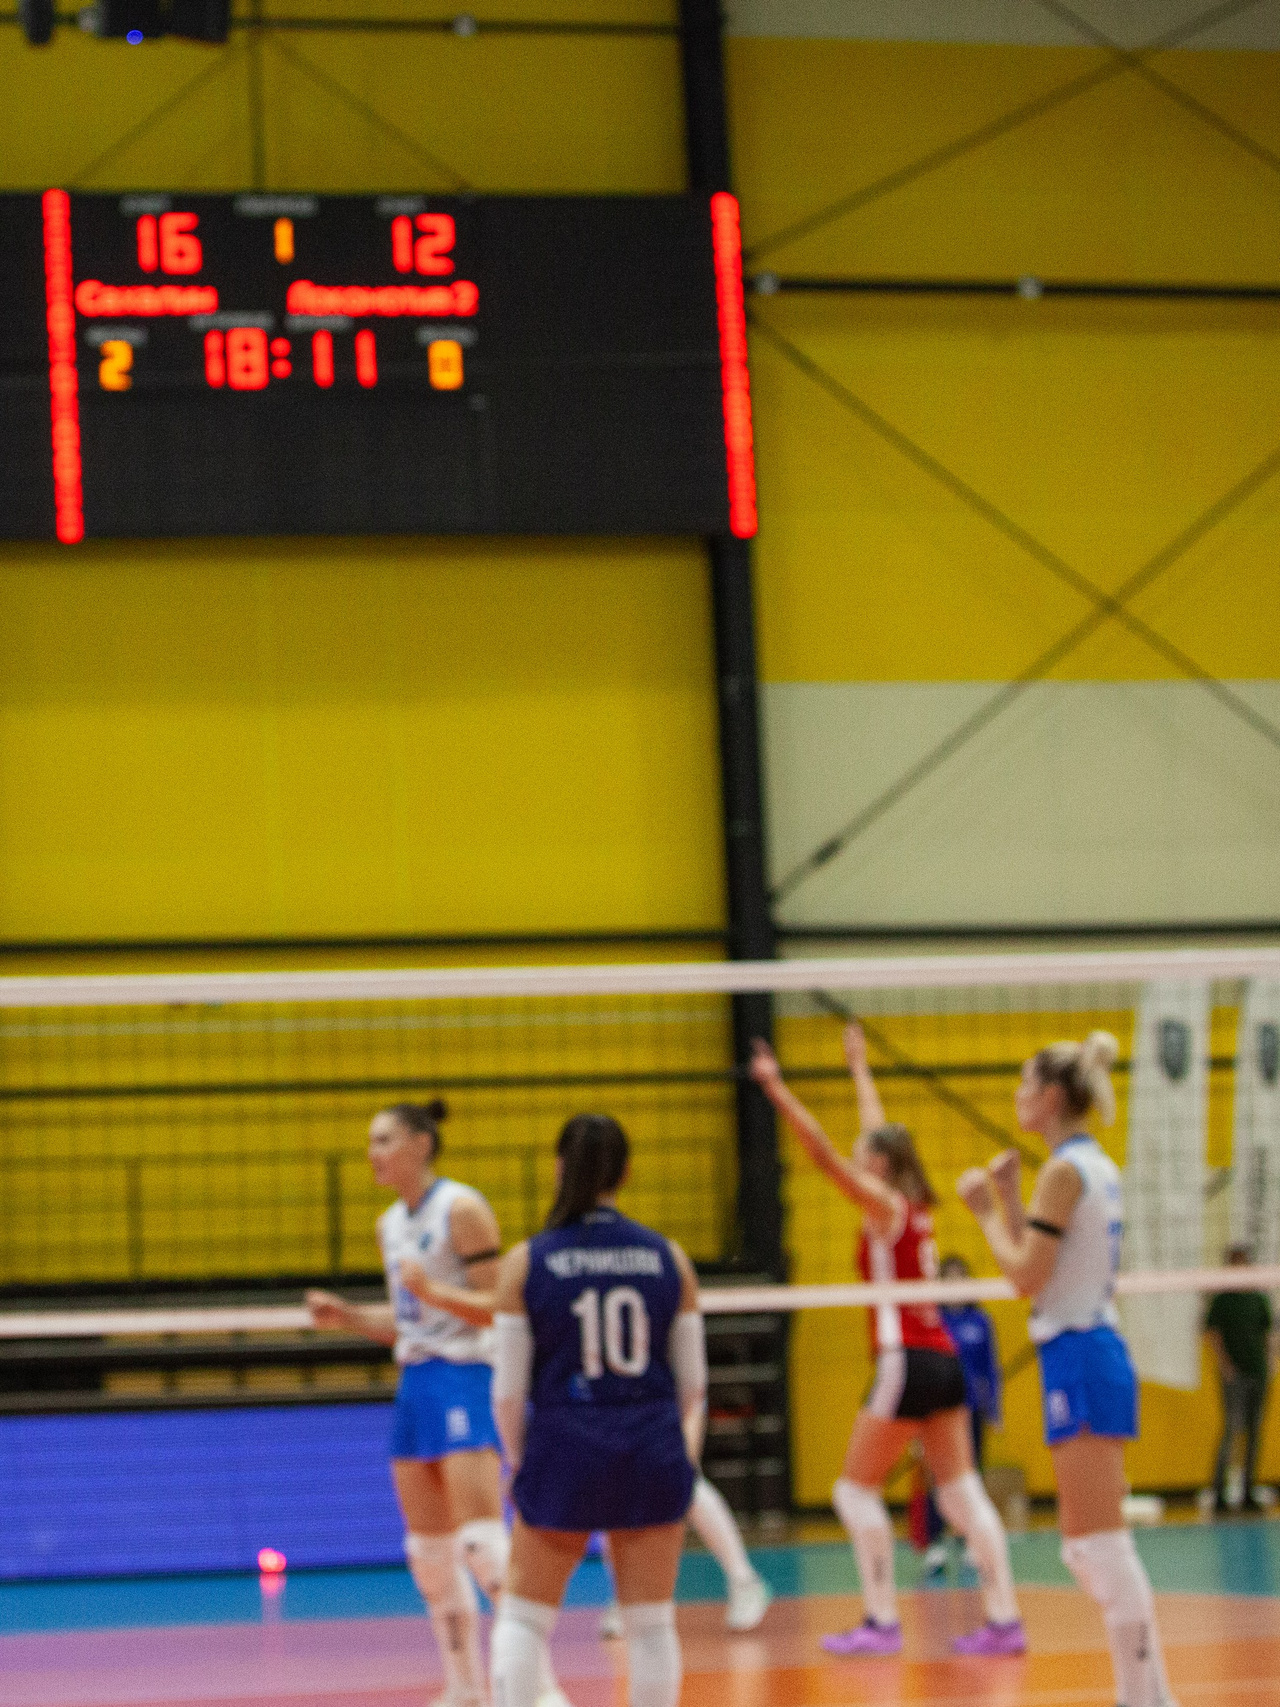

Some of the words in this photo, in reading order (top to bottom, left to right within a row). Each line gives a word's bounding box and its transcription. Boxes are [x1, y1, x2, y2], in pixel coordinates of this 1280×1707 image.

[137, 212, 204, 275] 16
[274, 217, 294, 265] 1
[391, 213, 456, 276] 12
[99, 340, 134, 391] 2
[204, 327, 378, 391] 18:11
[570, 1285, 651, 1379] 10
